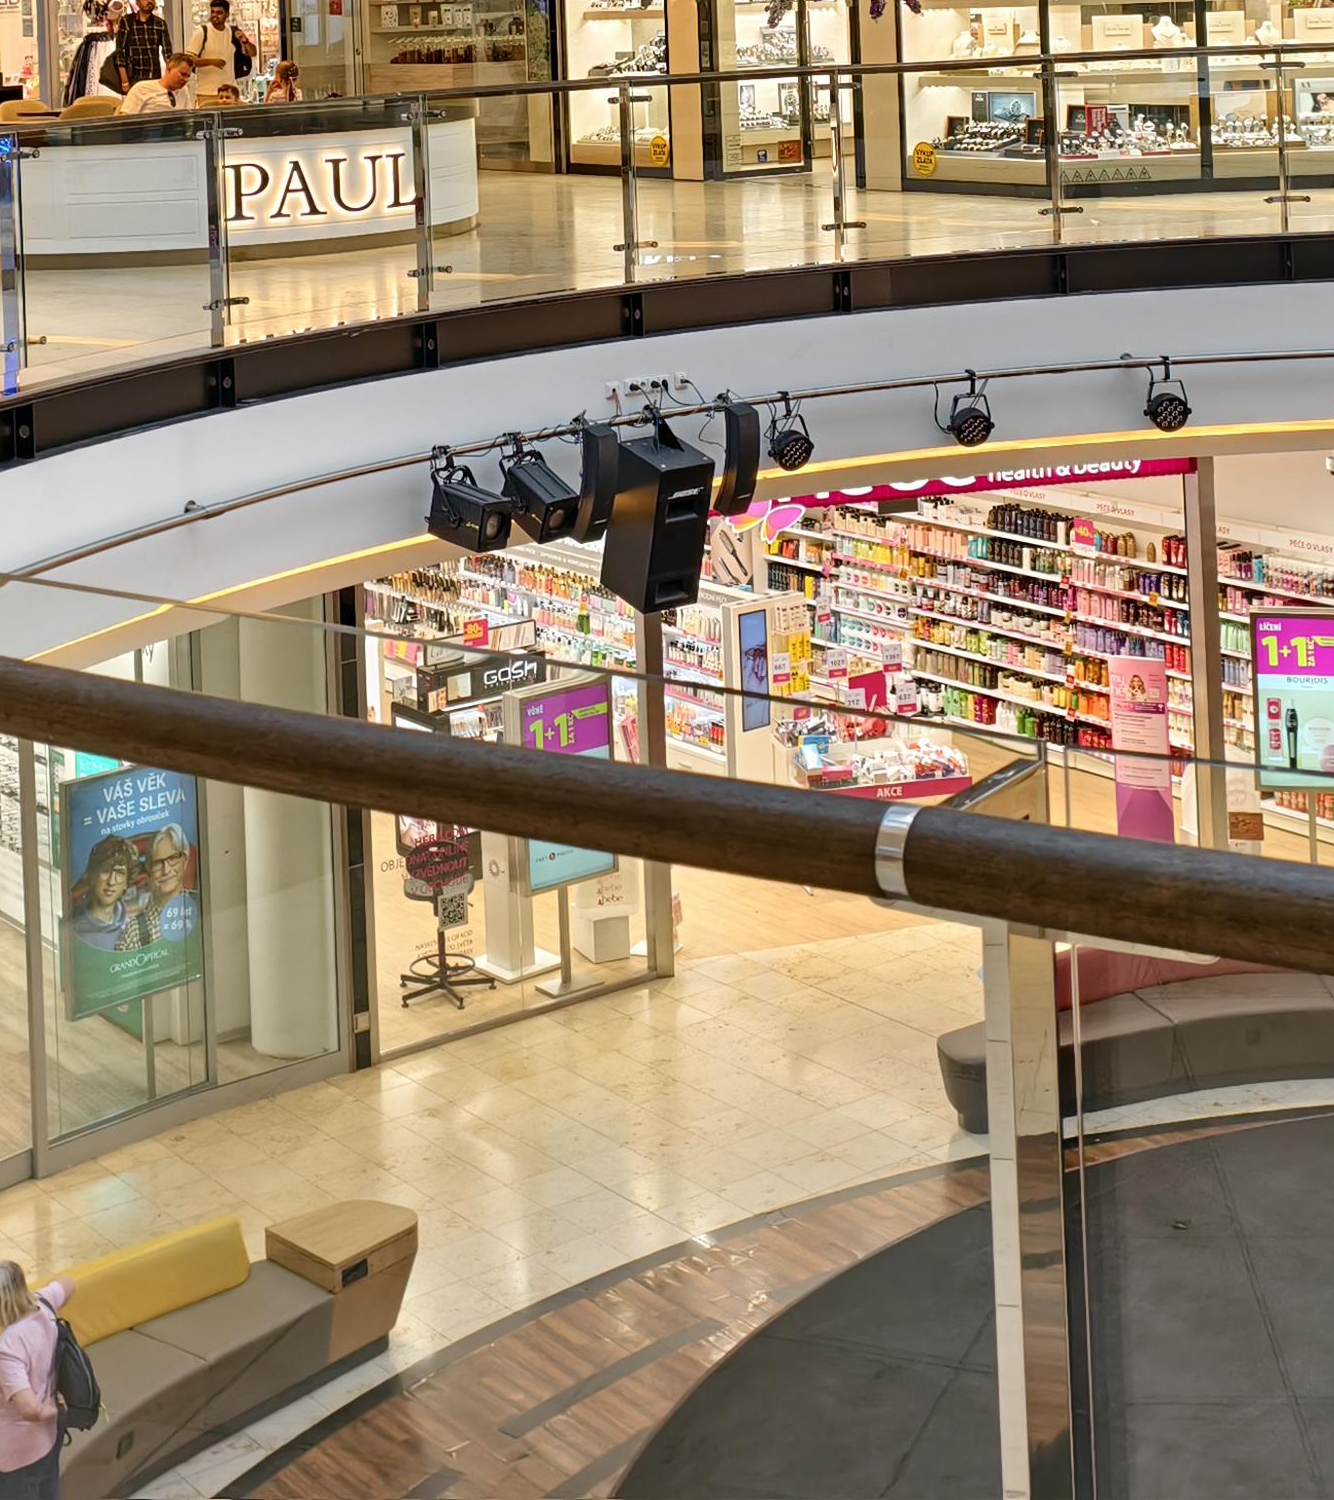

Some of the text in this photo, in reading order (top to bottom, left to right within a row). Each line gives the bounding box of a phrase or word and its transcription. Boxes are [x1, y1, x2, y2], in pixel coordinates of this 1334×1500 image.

[222, 152, 417, 222] PAUL
[1261, 635, 1308, 668] 1+1
[483, 660, 538, 686] GOSH
[1286, 675, 1329, 685] BOURJOIS
[529, 712, 568, 751] 1+1
[103, 772, 167, 803] VÁŠ VĚK
[875, 785, 903, 799] AKCE
[96, 799, 136, 825] VAŠE
[138, 788, 186, 813] SLEVA
[100, 808, 171, 837] na stovky obrouček
[166, 907, 179, 919] 69
[170, 920, 184, 931] 69
